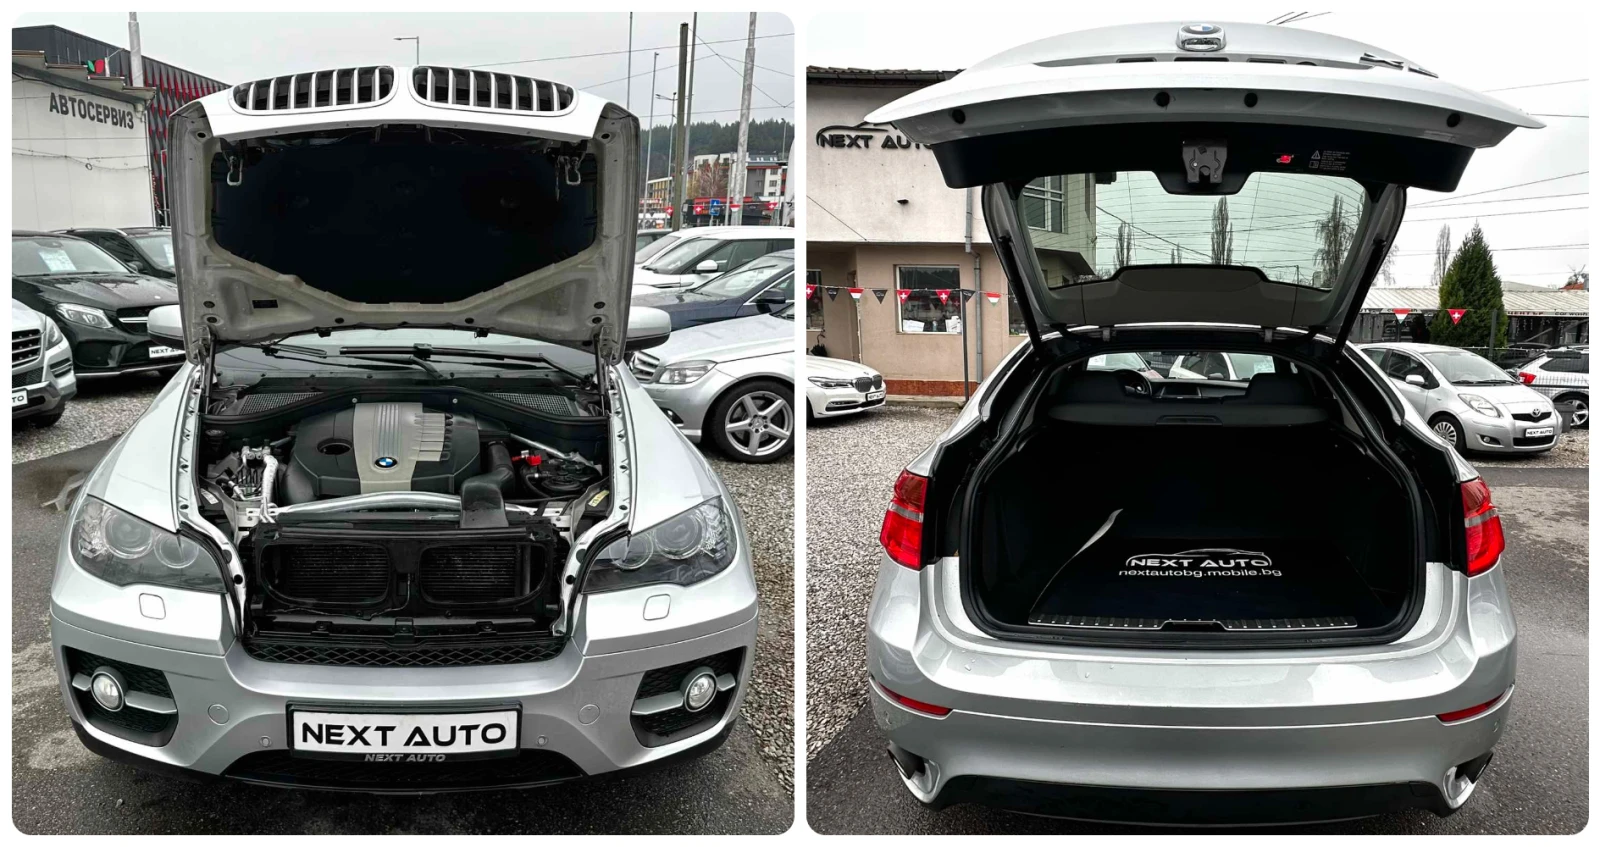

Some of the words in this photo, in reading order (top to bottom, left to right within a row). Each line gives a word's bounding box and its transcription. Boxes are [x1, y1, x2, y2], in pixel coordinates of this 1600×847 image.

[49, 92, 134, 129] АВТОСЕРВИЗ
[819, 134, 873, 148] NEXT
[880, 135, 932, 149] AU
[1130, 558, 1194, 567] NEXT
[1199, 558, 1269, 567] AUTO
[1118, 568, 1282, 578] nextautobg.mobile.bg
[302, 722, 397, 746] NEXT
[403, 723, 507, 746] AUTO
[364, 753, 404, 762] NEXT
[405, 753, 446, 762] AUTO
